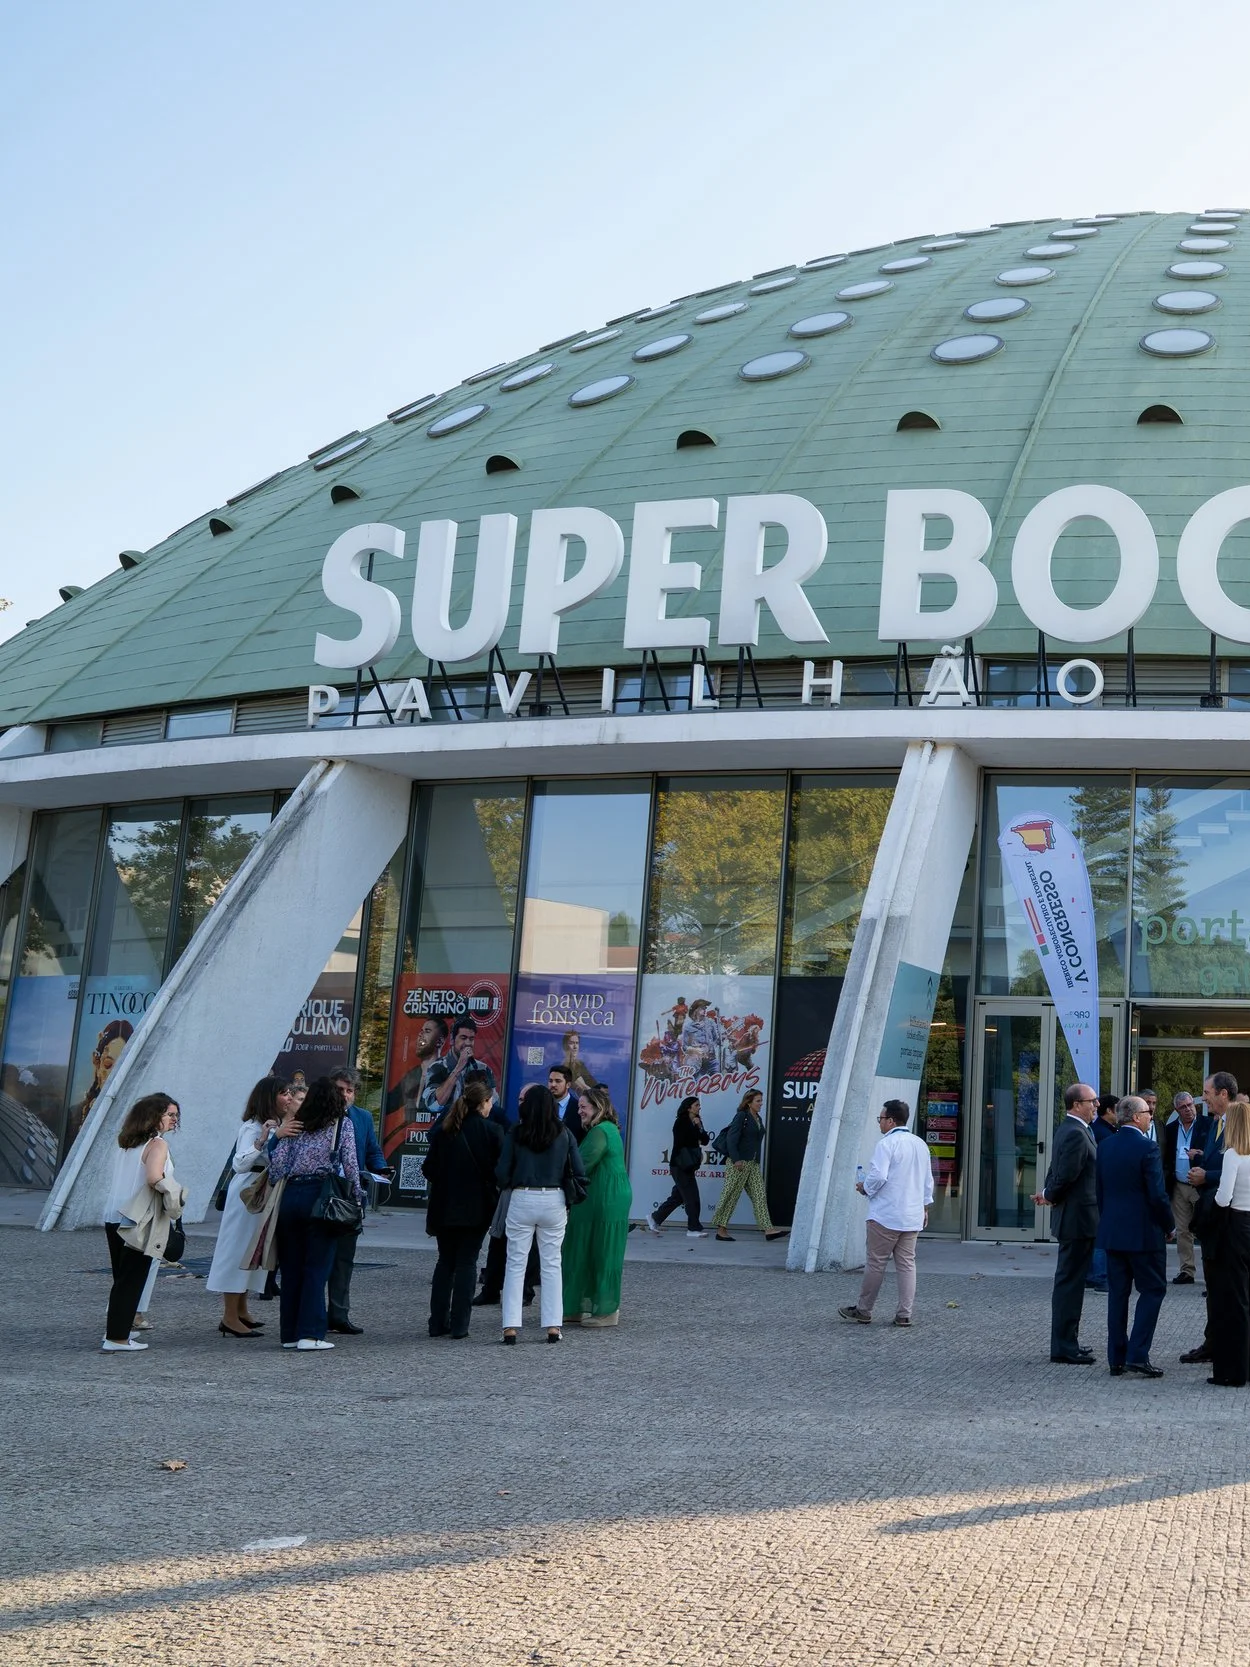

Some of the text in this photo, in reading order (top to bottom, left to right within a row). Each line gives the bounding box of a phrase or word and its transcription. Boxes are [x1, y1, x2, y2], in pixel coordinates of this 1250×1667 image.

[314, 493, 830, 669] SUPER
[308, 645, 1104, 728] PAVILHÃO
[407, 987, 422, 1002] ZÉ
[423, 990, 456, 1002] NETO
[297, 1000, 345, 1018] RIQUE
[403, 1002, 466, 1014] CRISTIANO
[291, 1017, 350, 1036] ULIANO
[783, 1081, 821, 1099] SUP
[651, 1168, 672, 1176] SUP
[695, 1170, 707, 1178] CK
